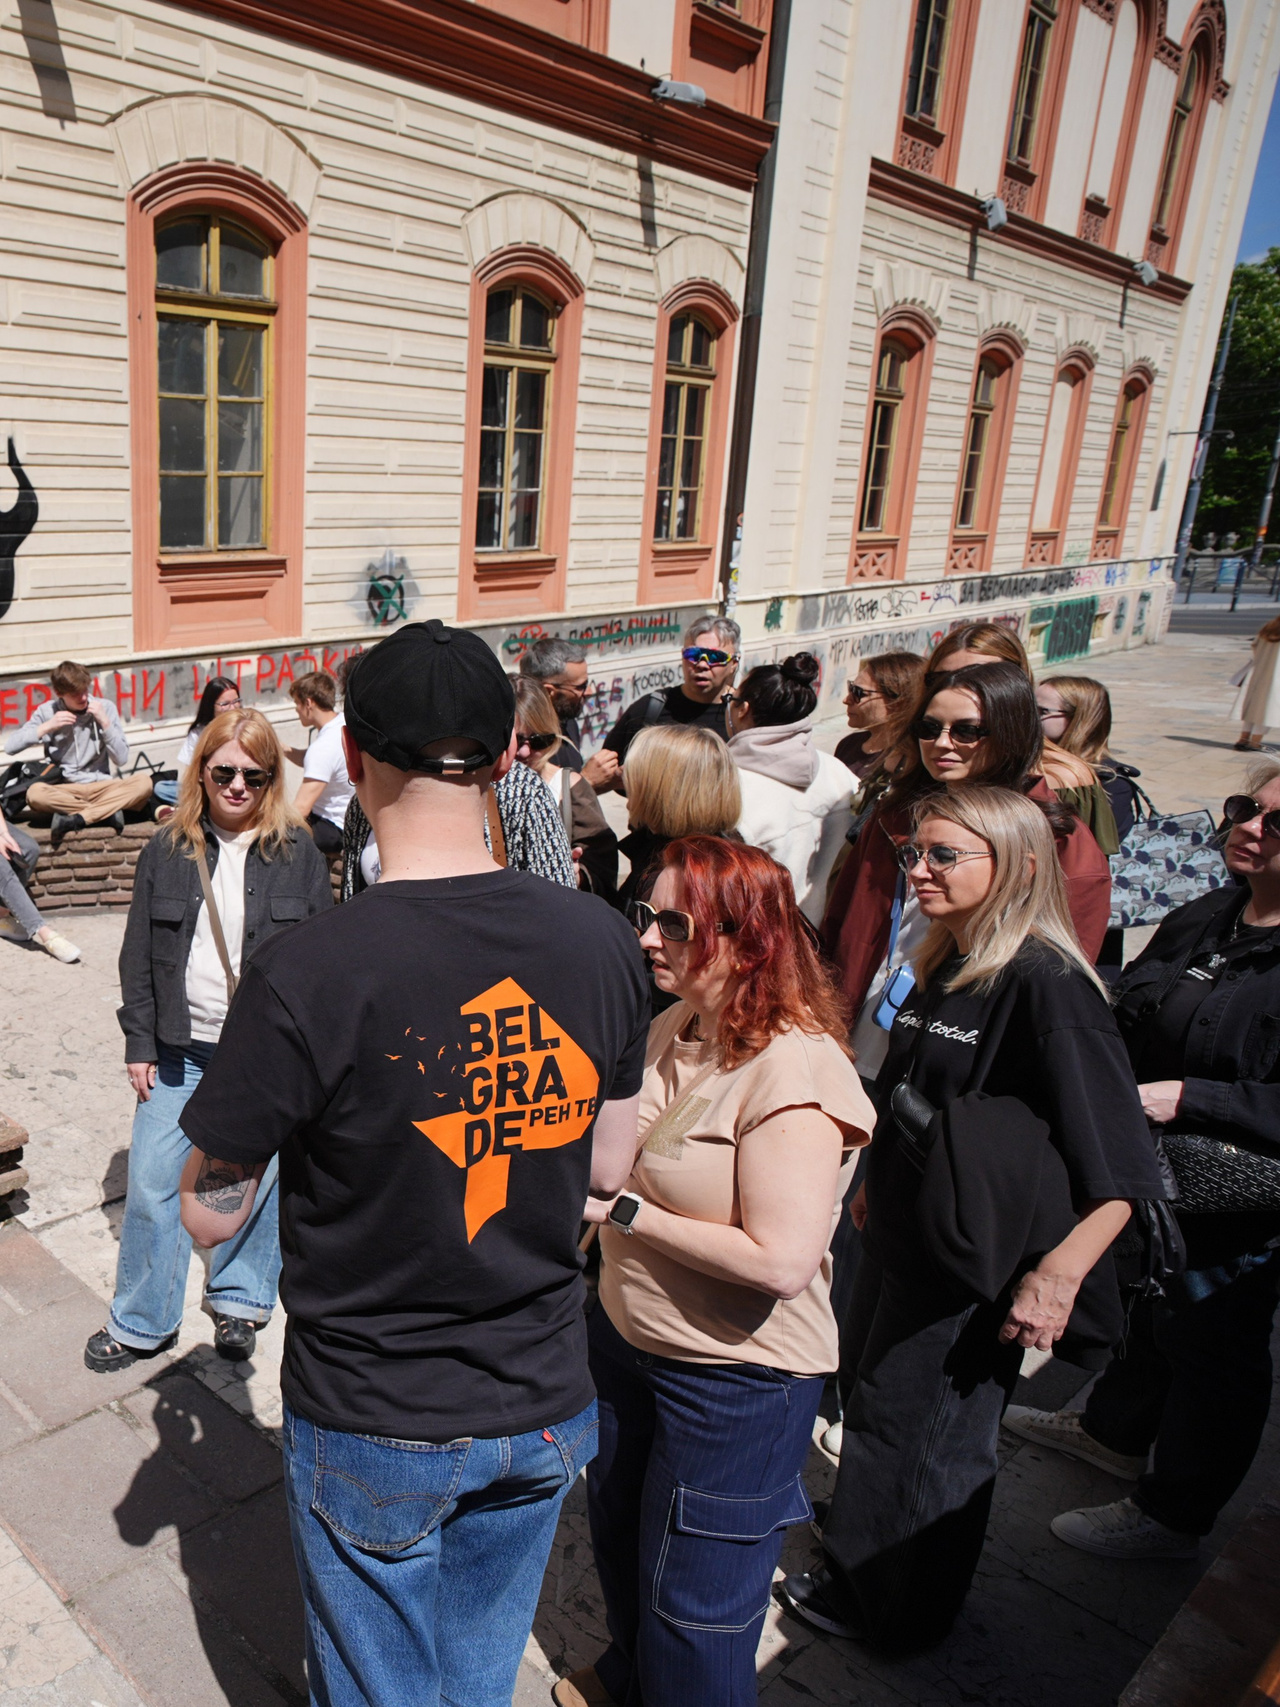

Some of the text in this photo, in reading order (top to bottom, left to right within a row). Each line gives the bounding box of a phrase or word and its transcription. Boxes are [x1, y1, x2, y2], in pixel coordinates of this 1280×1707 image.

[631, 668, 675, 700] КОСОВО
[461, 1003, 561, 1065] BEL
[928, 1019, 980, 1045] total.
[464, 1054, 569, 1116] GRA
[464, 1110, 526, 1168] DE
